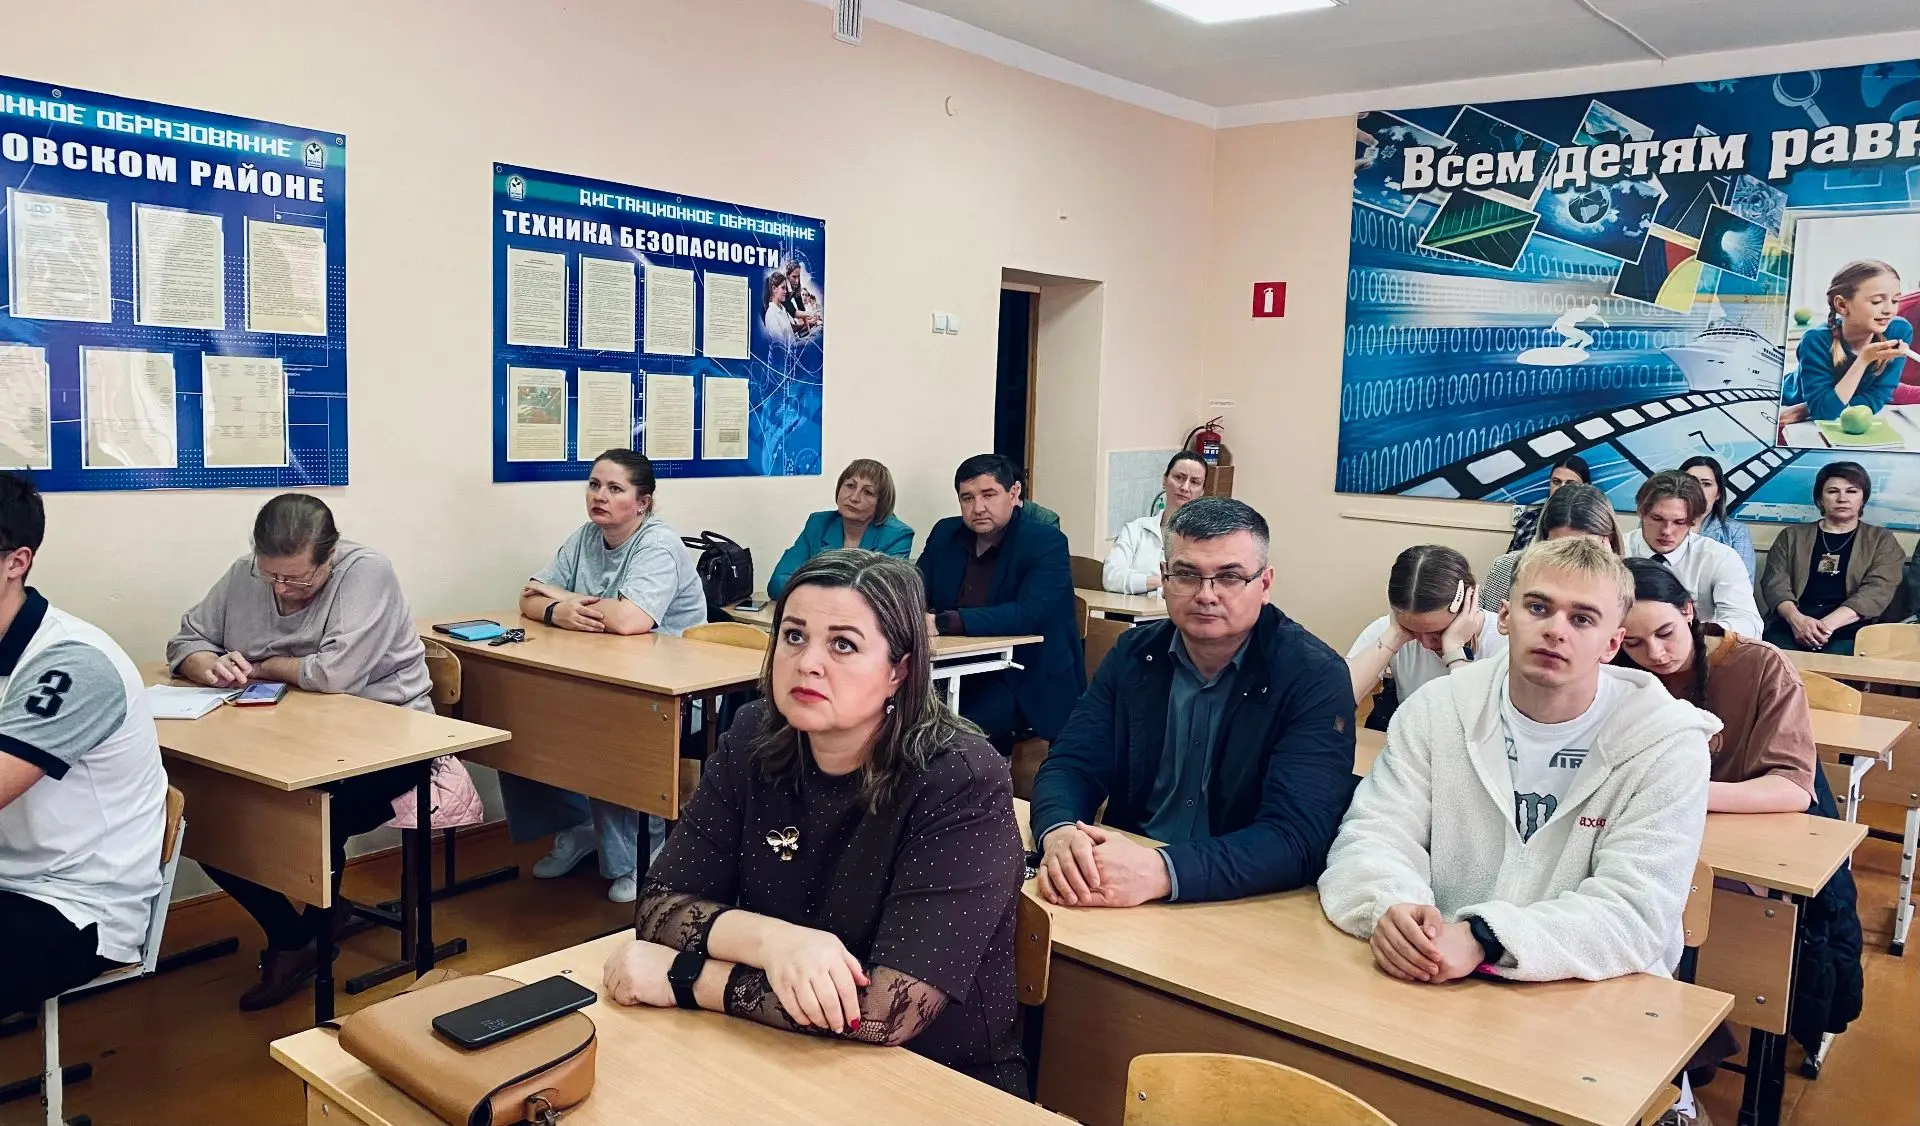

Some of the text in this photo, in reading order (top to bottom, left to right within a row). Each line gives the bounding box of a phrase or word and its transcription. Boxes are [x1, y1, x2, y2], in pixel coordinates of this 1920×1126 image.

[96, 110, 293, 158] ОБРАЗОВАНИЕ
[2, 132, 325, 202] ОВСКОМ РАЙОНЕ
[1403, 147, 1535, 188] Всем
[1552, 134, 1745, 188] детям
[502, 209, 779, 268] ТЕХНИКА БЕЗОПАСНОСТИ
[580, 189, 816, 241] ДИСТАНЦИОННОЕ ОБРАЗОВАНИЕ
[24, 669, 73, 718] 3
